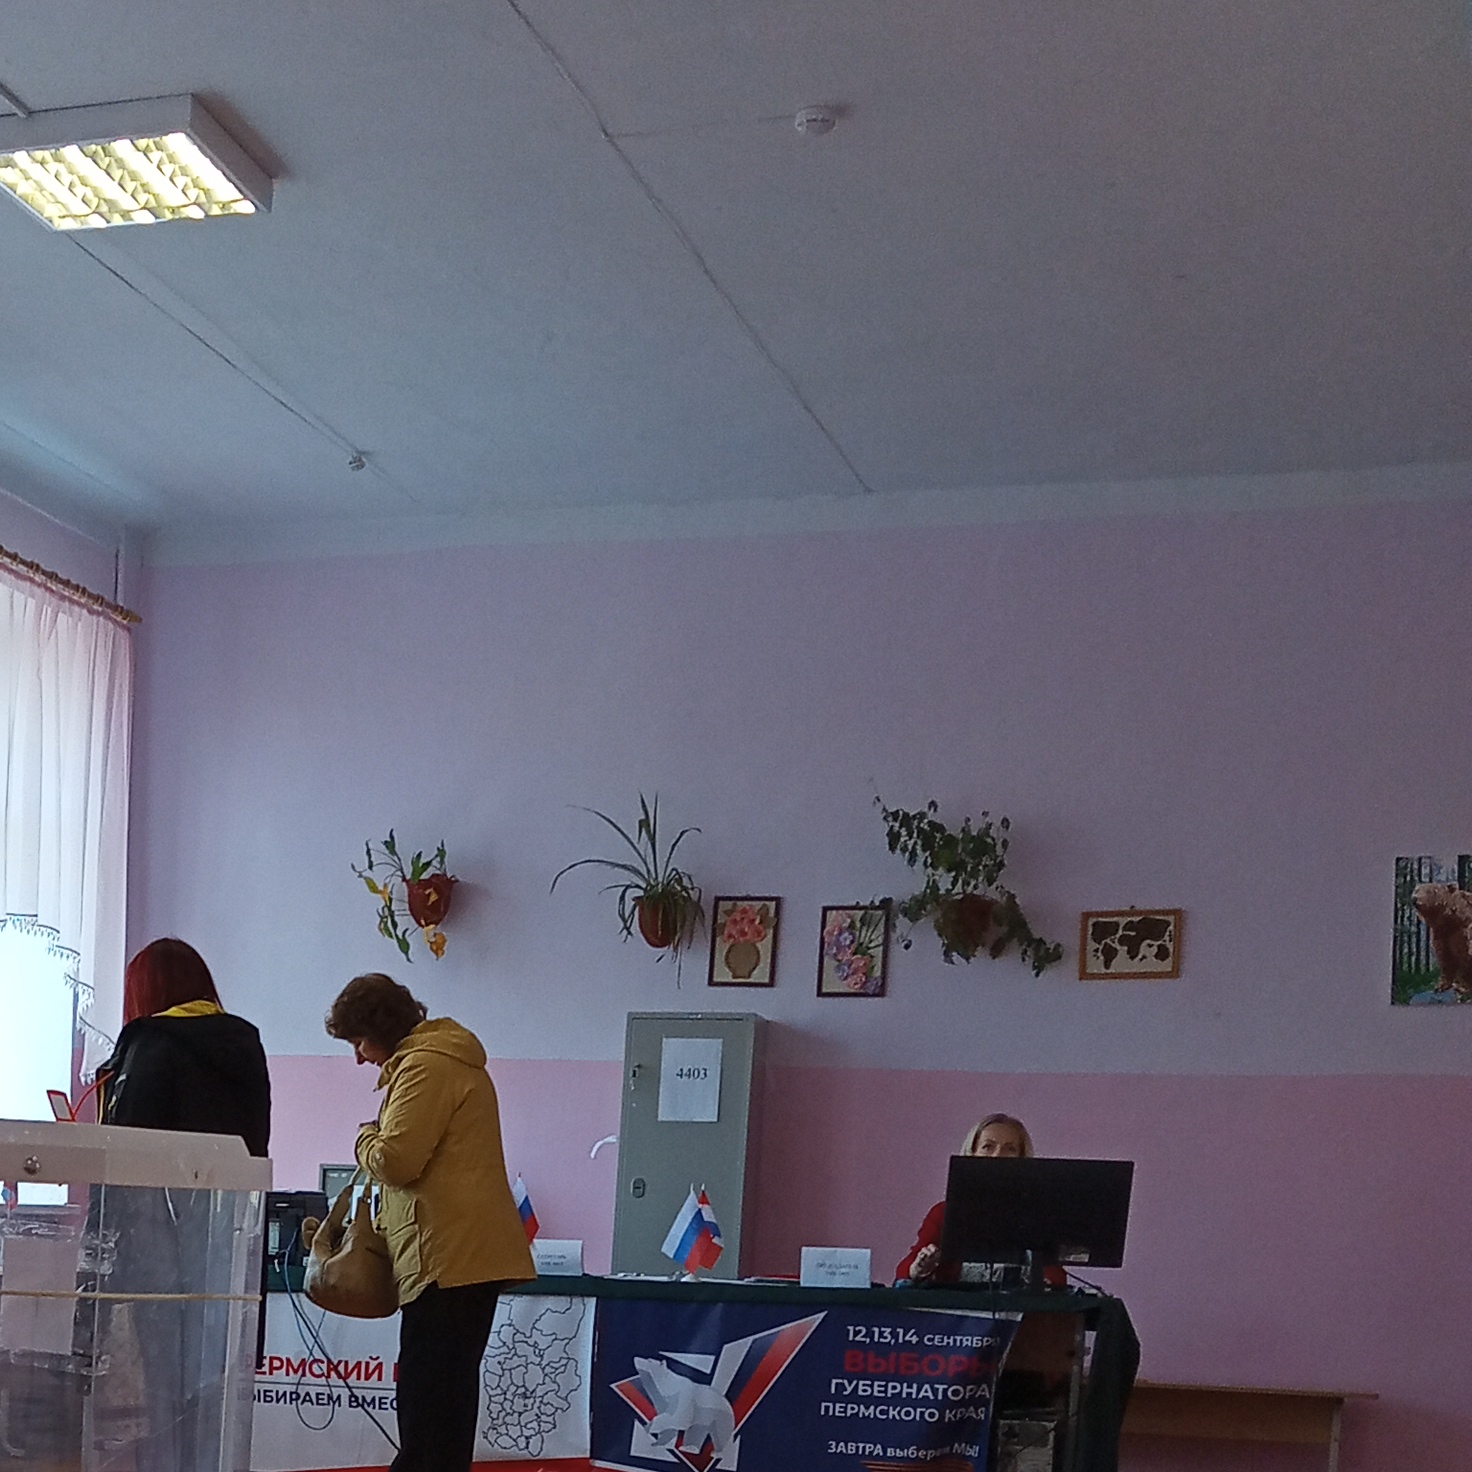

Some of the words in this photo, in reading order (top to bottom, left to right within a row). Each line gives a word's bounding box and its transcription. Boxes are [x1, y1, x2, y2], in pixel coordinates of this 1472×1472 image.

[676, 1068, 708, 1080] 4403
[846, 1325, 919, 1346] 12,13,14
[255, 1355, 385, 1382] ЕРМСКИЙ
[253, 1388, 342, 1408] ЫБИРАЕМ
[348, 1393, 398, 1412] ВМЕС
[830, 1379, 990, 1401] ГУБЕРНАТОРА
[820, 1402, 939, 1422] ПЕРМСКОГО
[944, 1407, 986, 1423] КРАЯ
[828, 1441, 883, 1457] ЗАВТРА
